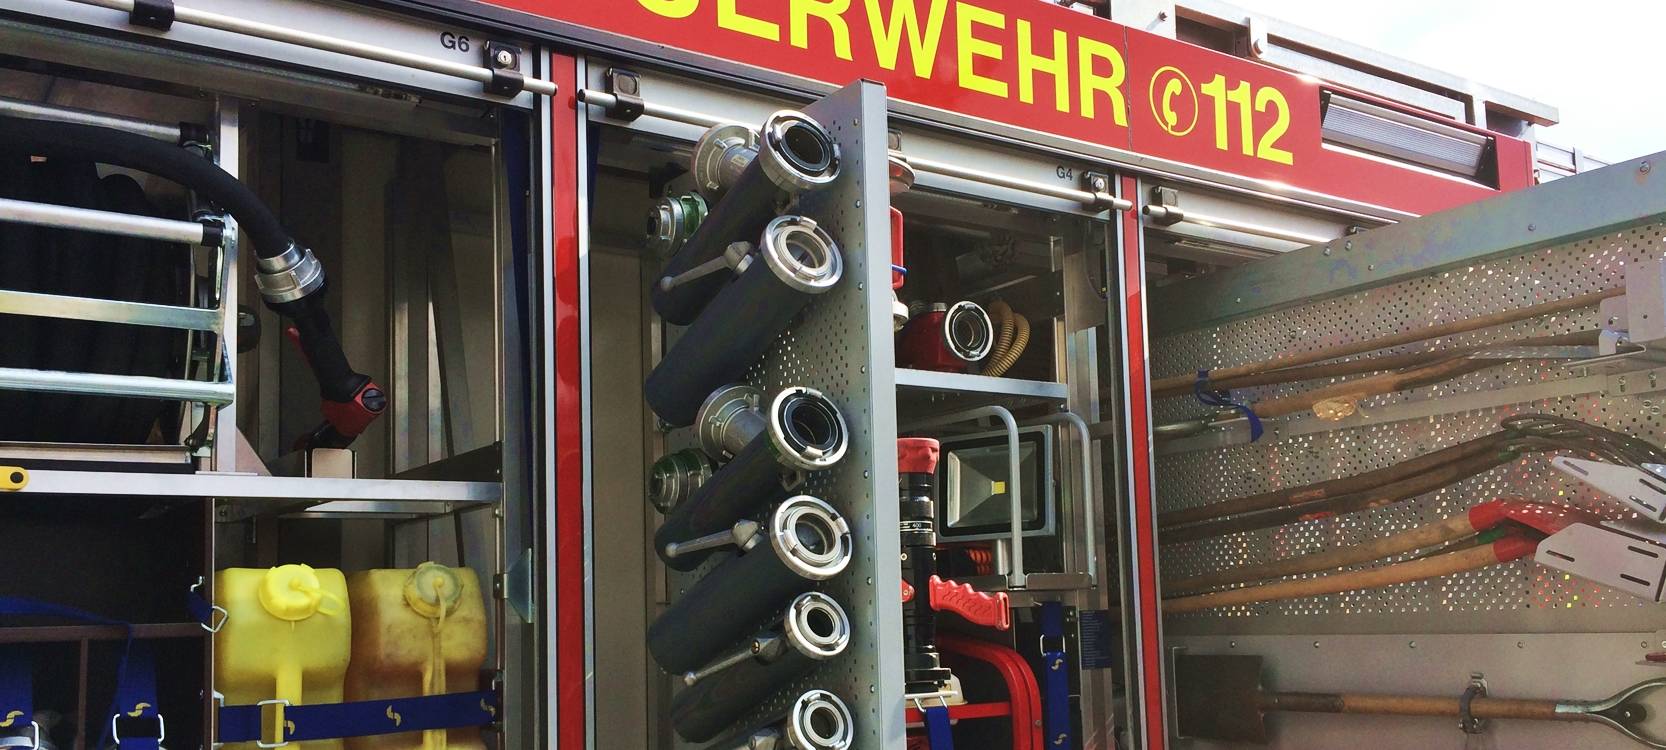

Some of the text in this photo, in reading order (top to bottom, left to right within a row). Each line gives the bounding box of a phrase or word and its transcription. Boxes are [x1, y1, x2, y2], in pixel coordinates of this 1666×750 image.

[440, 31, 470, 53] G6
[637, 0, 1294, 165] RWEHR 112
[1056, 165, 1074, 181] G4
